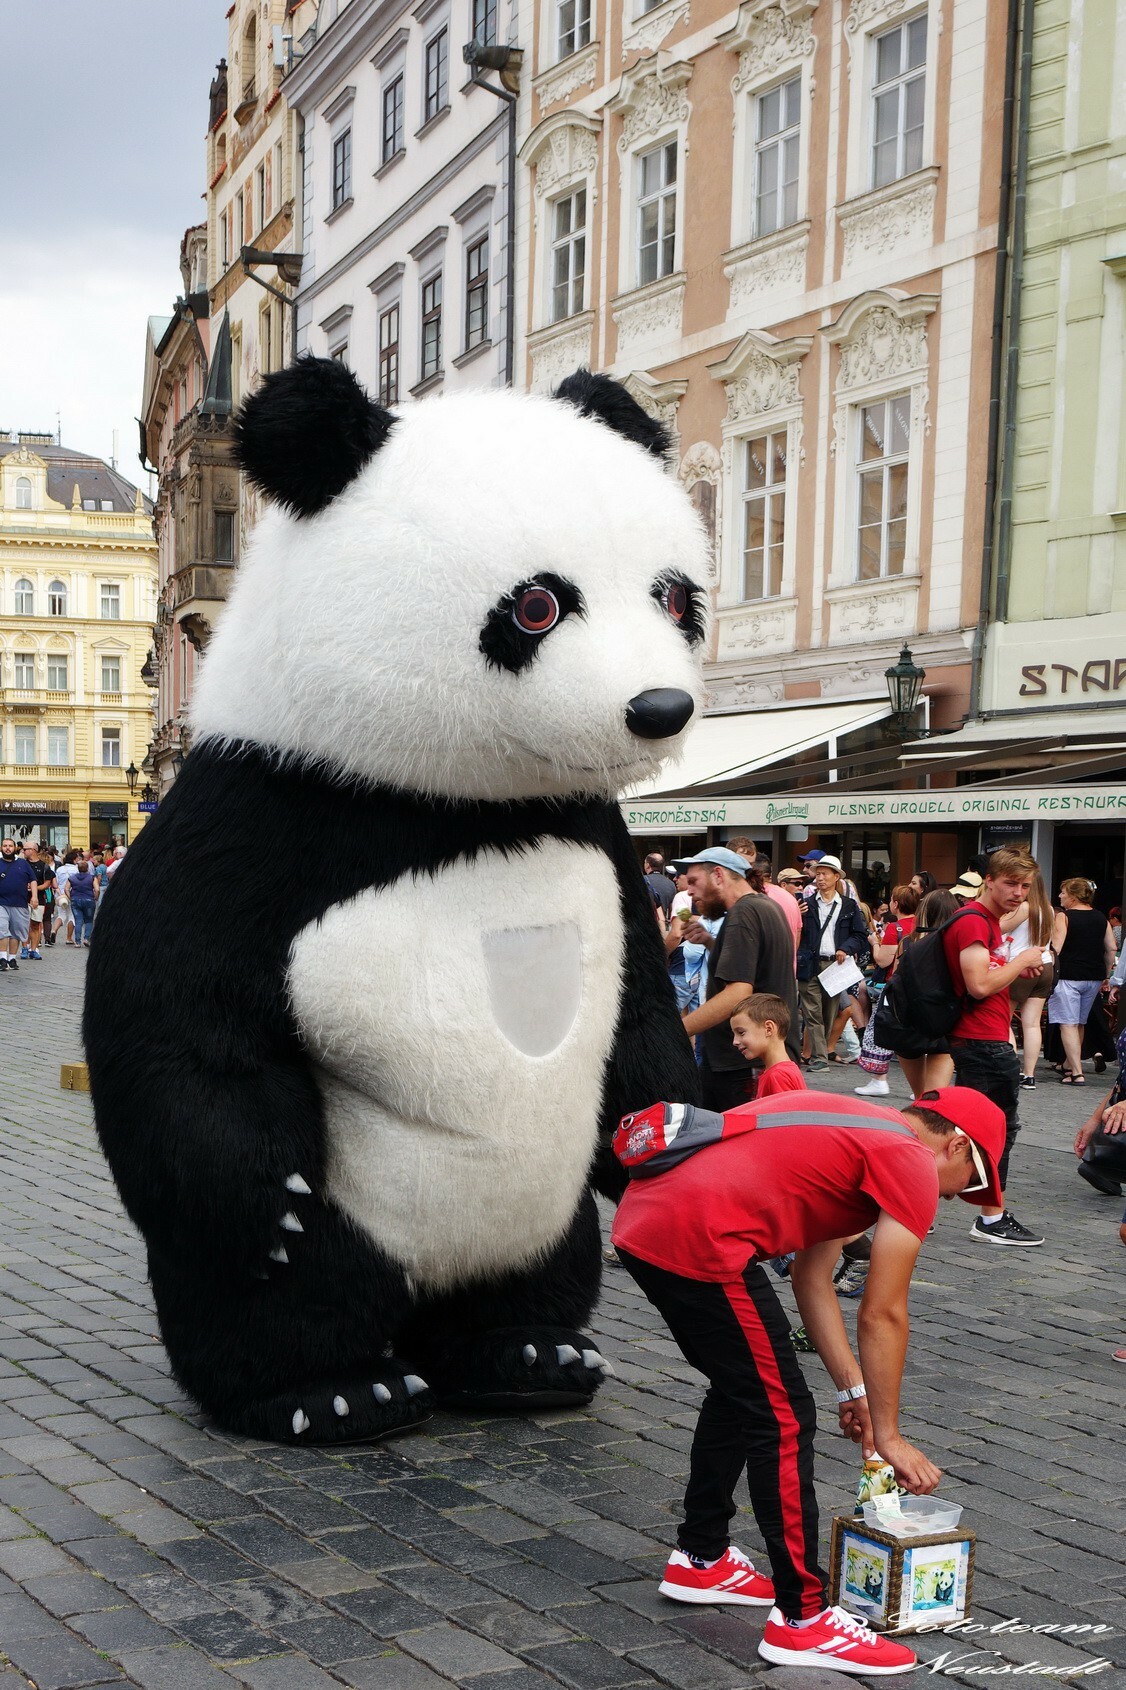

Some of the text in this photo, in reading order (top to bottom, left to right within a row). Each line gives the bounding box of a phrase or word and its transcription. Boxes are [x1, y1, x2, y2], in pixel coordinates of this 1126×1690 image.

[15, 707, 36, 715] HOTEL
[12, 801, 47, 809] SWAROVSKI
[828, 795, 1126, 816] PILSNER URQUELL ORIGINAL RESTAURA
[628, 803, 726, 824] STAROMĚSTSKÁ
